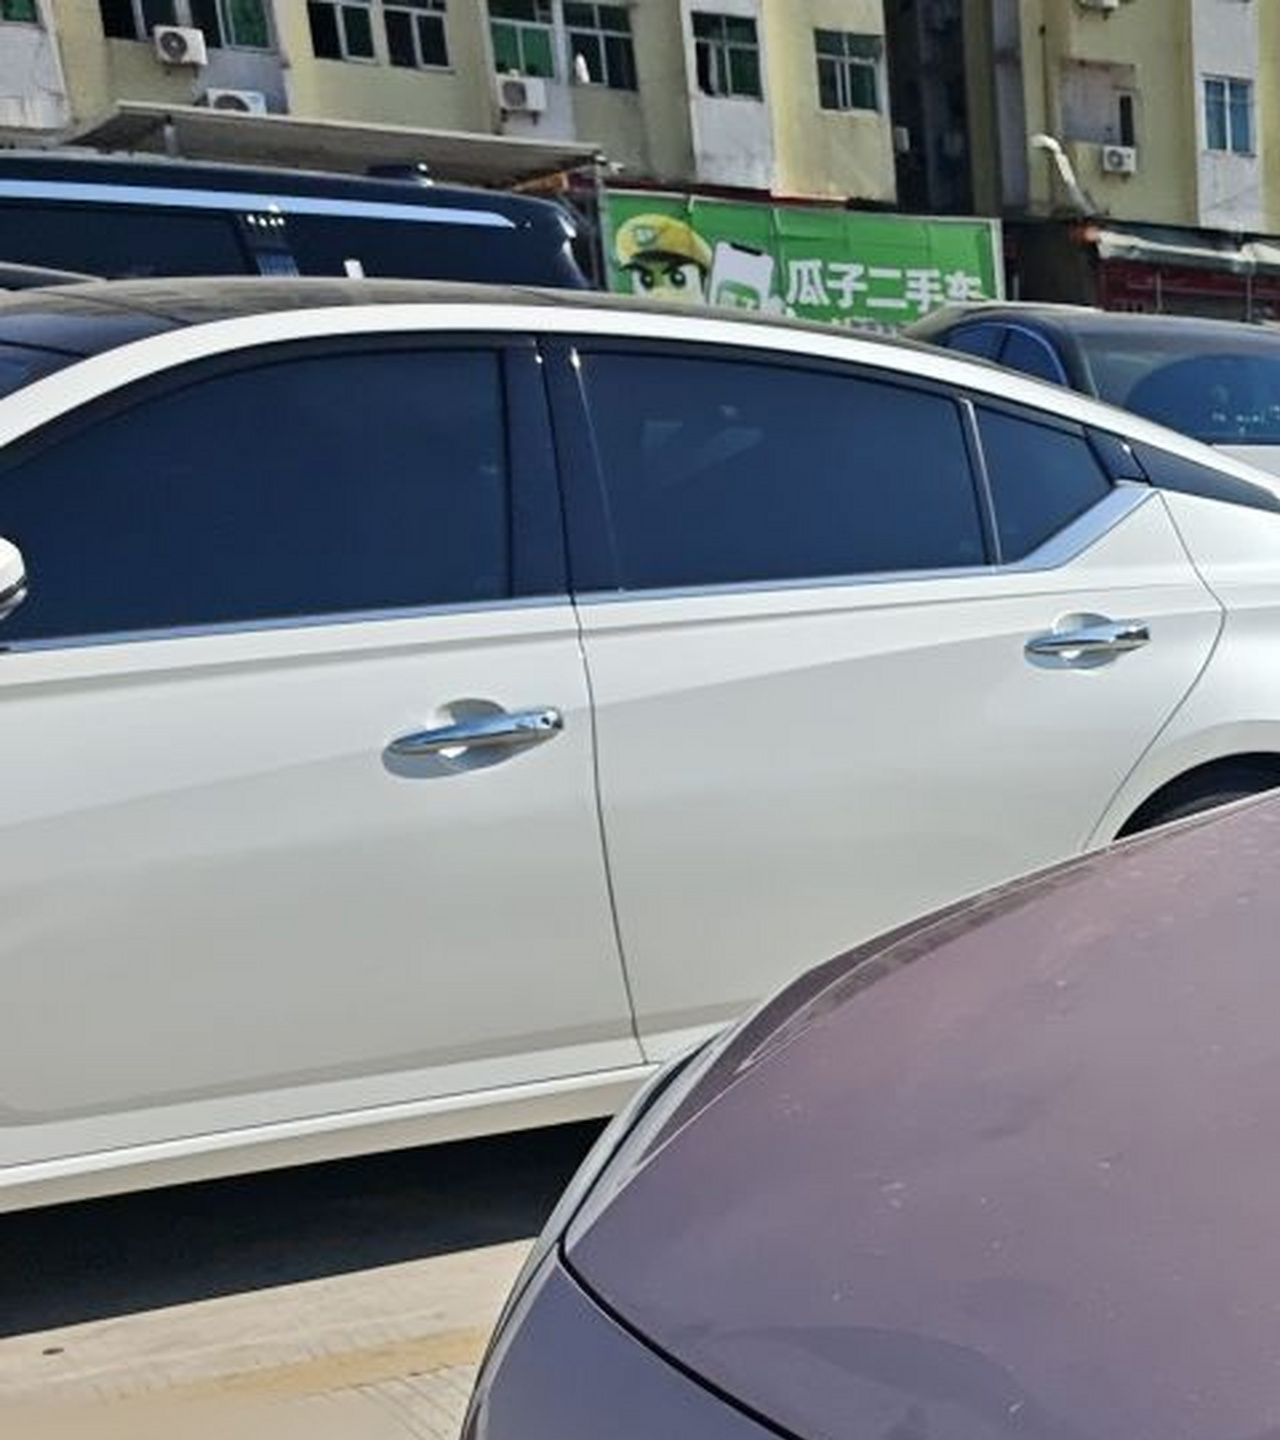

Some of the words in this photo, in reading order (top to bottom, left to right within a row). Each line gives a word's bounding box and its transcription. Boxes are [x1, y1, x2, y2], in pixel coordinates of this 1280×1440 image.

[786, 258, 986, 312] 瓜子二手车
